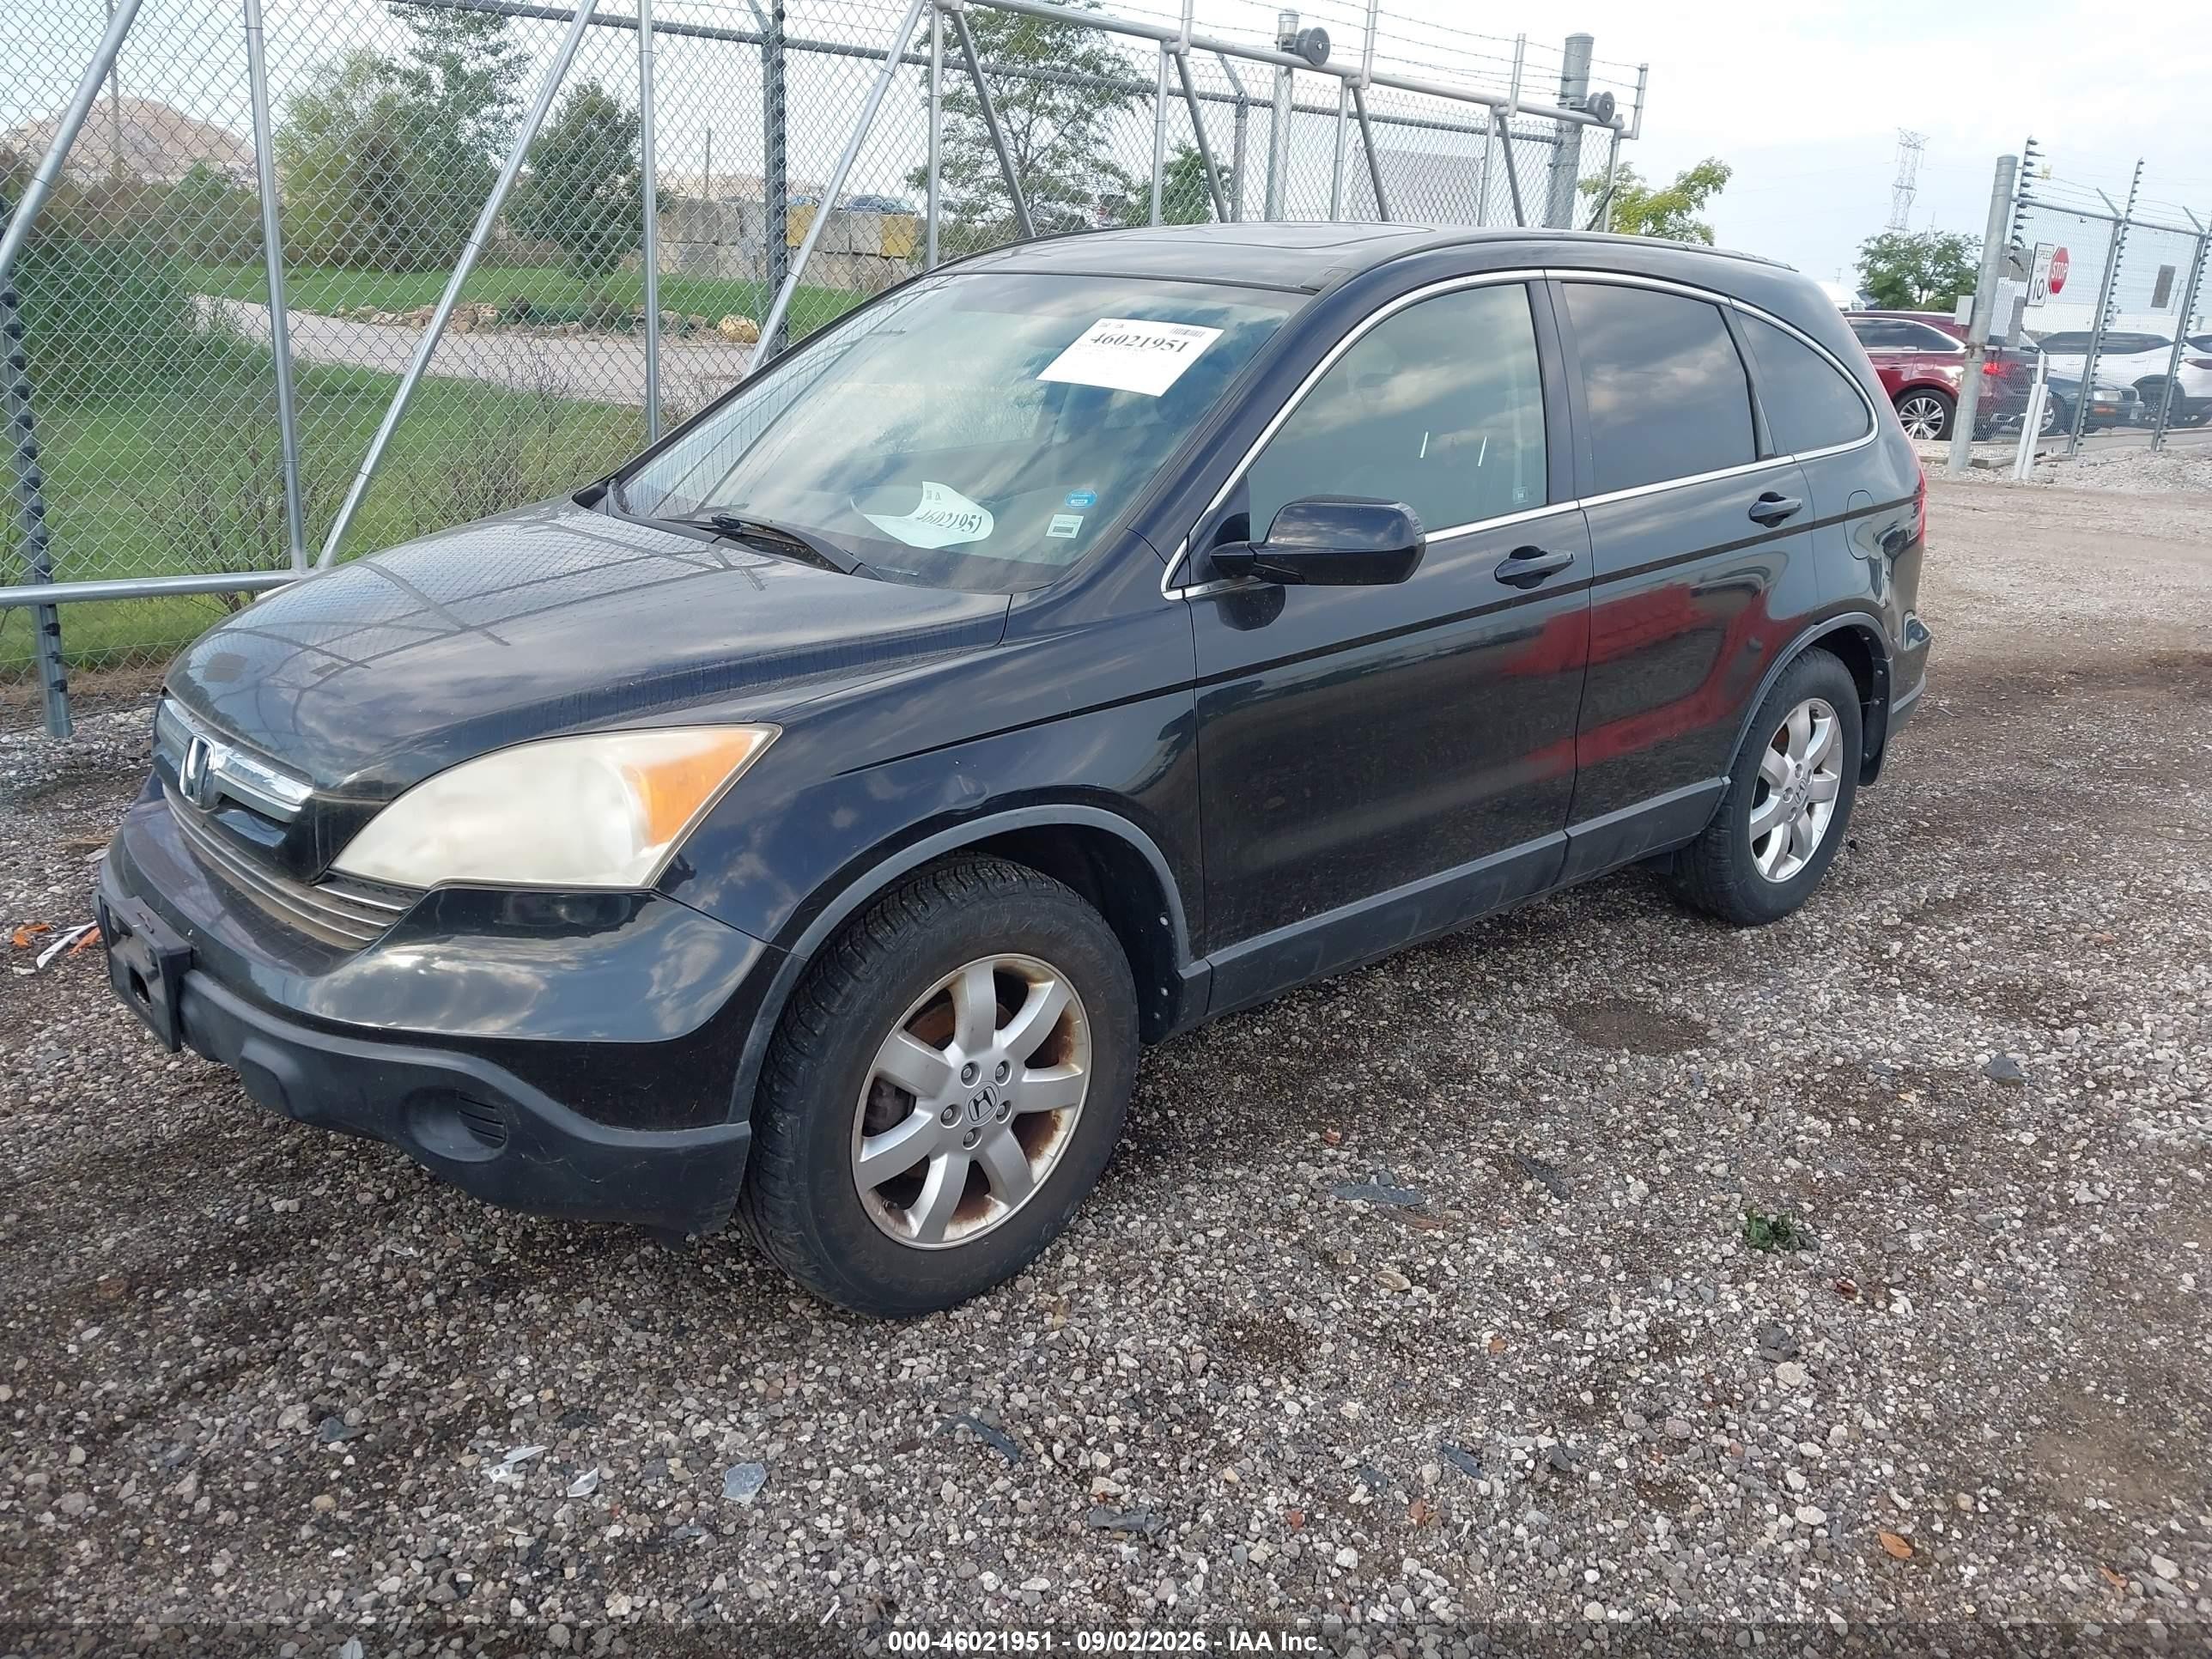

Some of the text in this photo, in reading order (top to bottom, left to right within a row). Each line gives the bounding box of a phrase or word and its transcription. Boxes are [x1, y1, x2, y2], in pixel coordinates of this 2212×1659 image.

[2038, 250, 2052, 259] SPEED
[2051, 261, 2069, 280] STOP
[2033, 278, 2045, 301] 10
[1090, 331, 1191, 353] 46021951
[915, 509, 982, 533] 46021951
